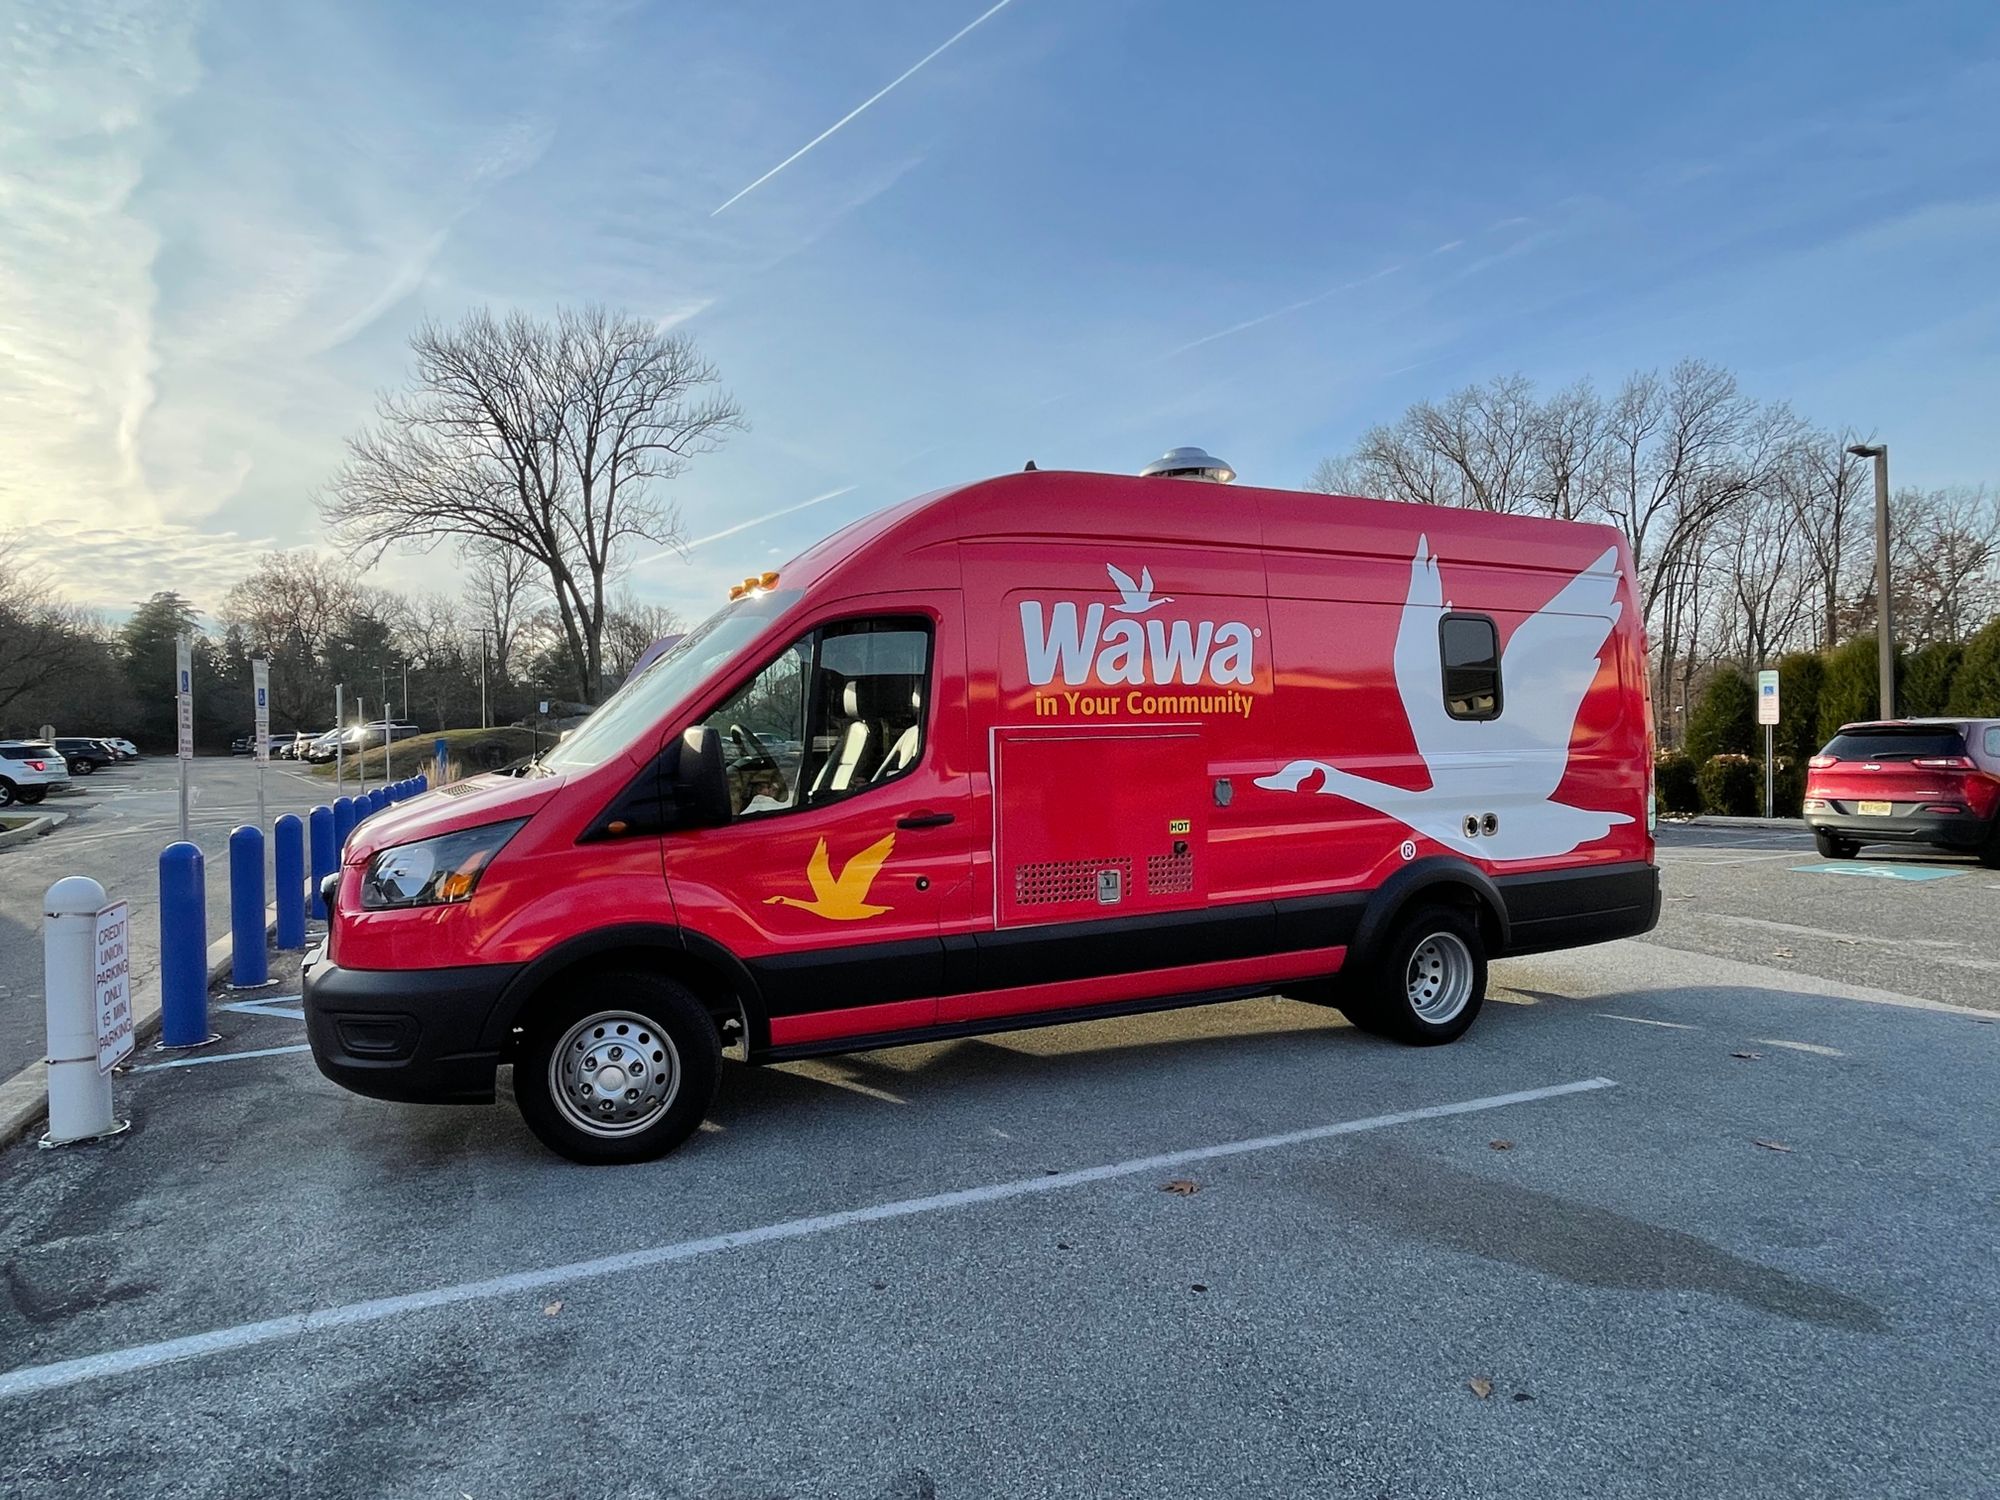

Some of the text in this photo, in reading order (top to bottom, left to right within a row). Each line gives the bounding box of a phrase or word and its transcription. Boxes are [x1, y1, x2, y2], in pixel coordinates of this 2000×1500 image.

[1019, 600, 1254, 686] Wawa
[1036, 690, 1253, 718] in Your Community
[1170, 822, 1189, 832] HOT
[98, 921, 125, 946] CREDIT
[100, 942, 124, 965] UNION
[97, 959, 129, 988] PARKING
[103, 983, 123, 1006] ONLY
[102, 1000, 127, 1028] 15 MIN
[99, 1017, 133, 1053] PARKING
